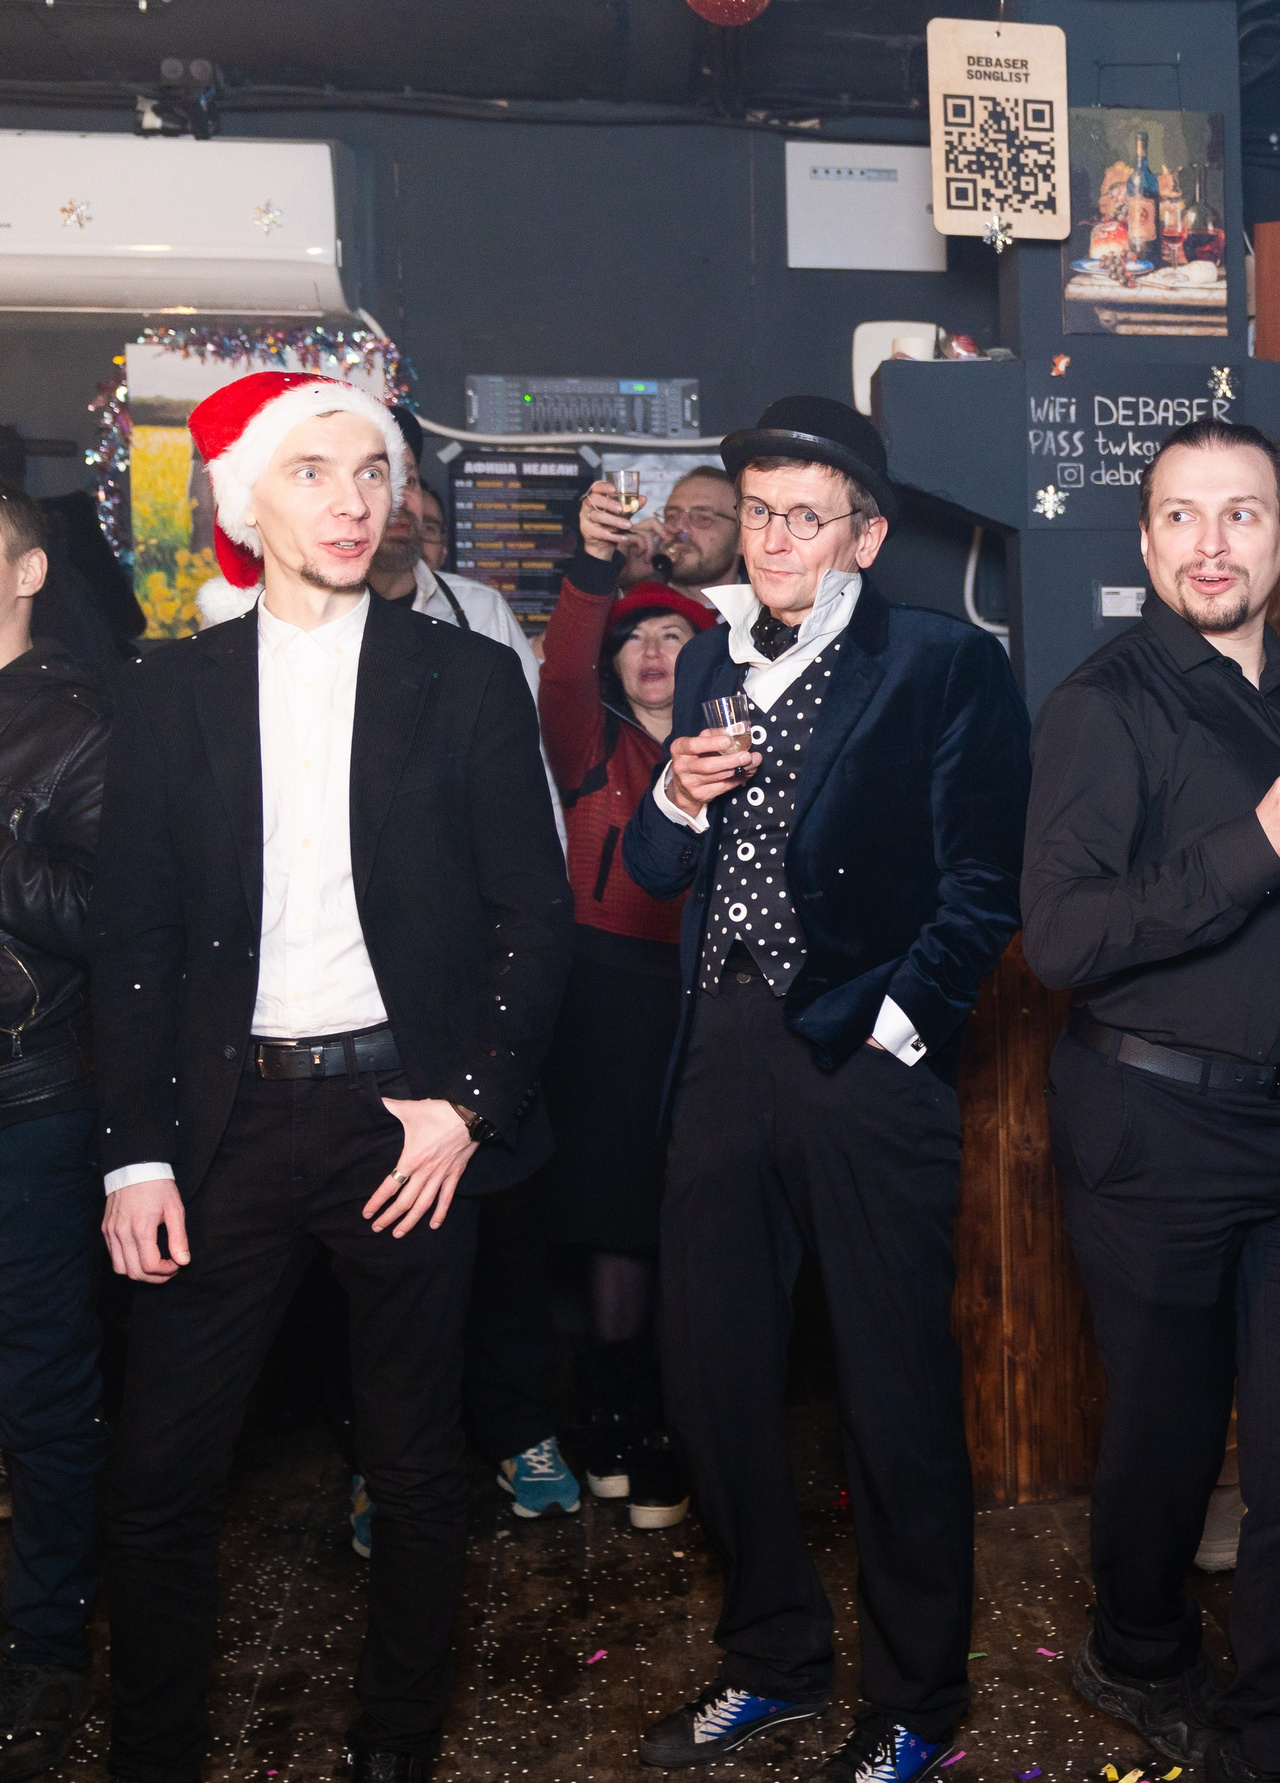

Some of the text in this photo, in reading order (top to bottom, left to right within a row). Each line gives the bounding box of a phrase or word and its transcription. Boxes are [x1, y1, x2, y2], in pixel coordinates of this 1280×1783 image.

[966, 55, 1029, 71] DEBASER
[966, 69, 1031, 84] SONGLIST
[1093, 395, 1234, 427] DEBASER
[1028, 429, 1085, 457] PASS
[463, 460, 518, 475] АФИША
